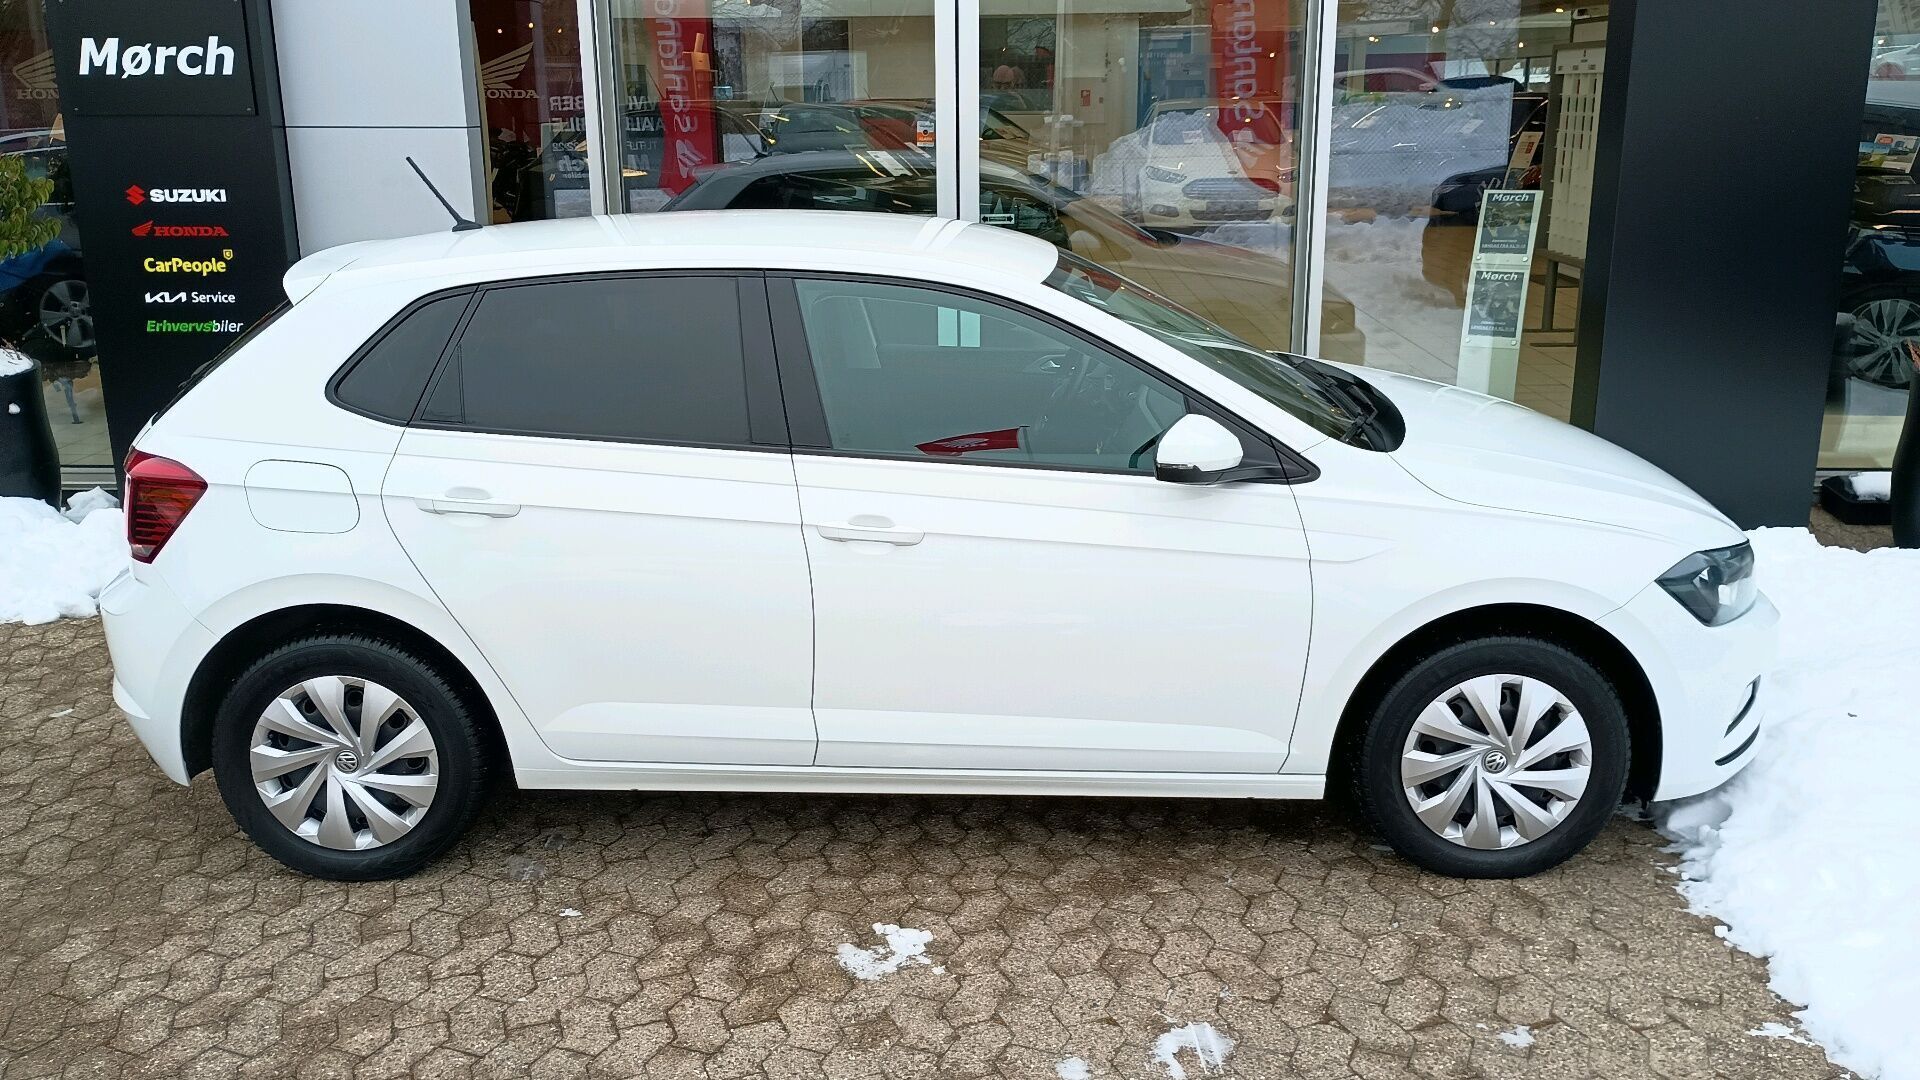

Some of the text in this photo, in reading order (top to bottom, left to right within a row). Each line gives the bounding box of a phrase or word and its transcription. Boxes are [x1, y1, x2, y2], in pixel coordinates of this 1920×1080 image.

[79, 35, 235, 79] Mørch
[16, 88, 59, 99] HON
[484, 89, 540, 99] ONDA
[150, 188, 227, 203] SUZUKI
[154, 226, 229, 237] HONDA
[144, 257, 226, 276] CarPeople
[145, 291, 236, 303] KIA Service
[146, 319, 244, 332] Erhvervsbiler
